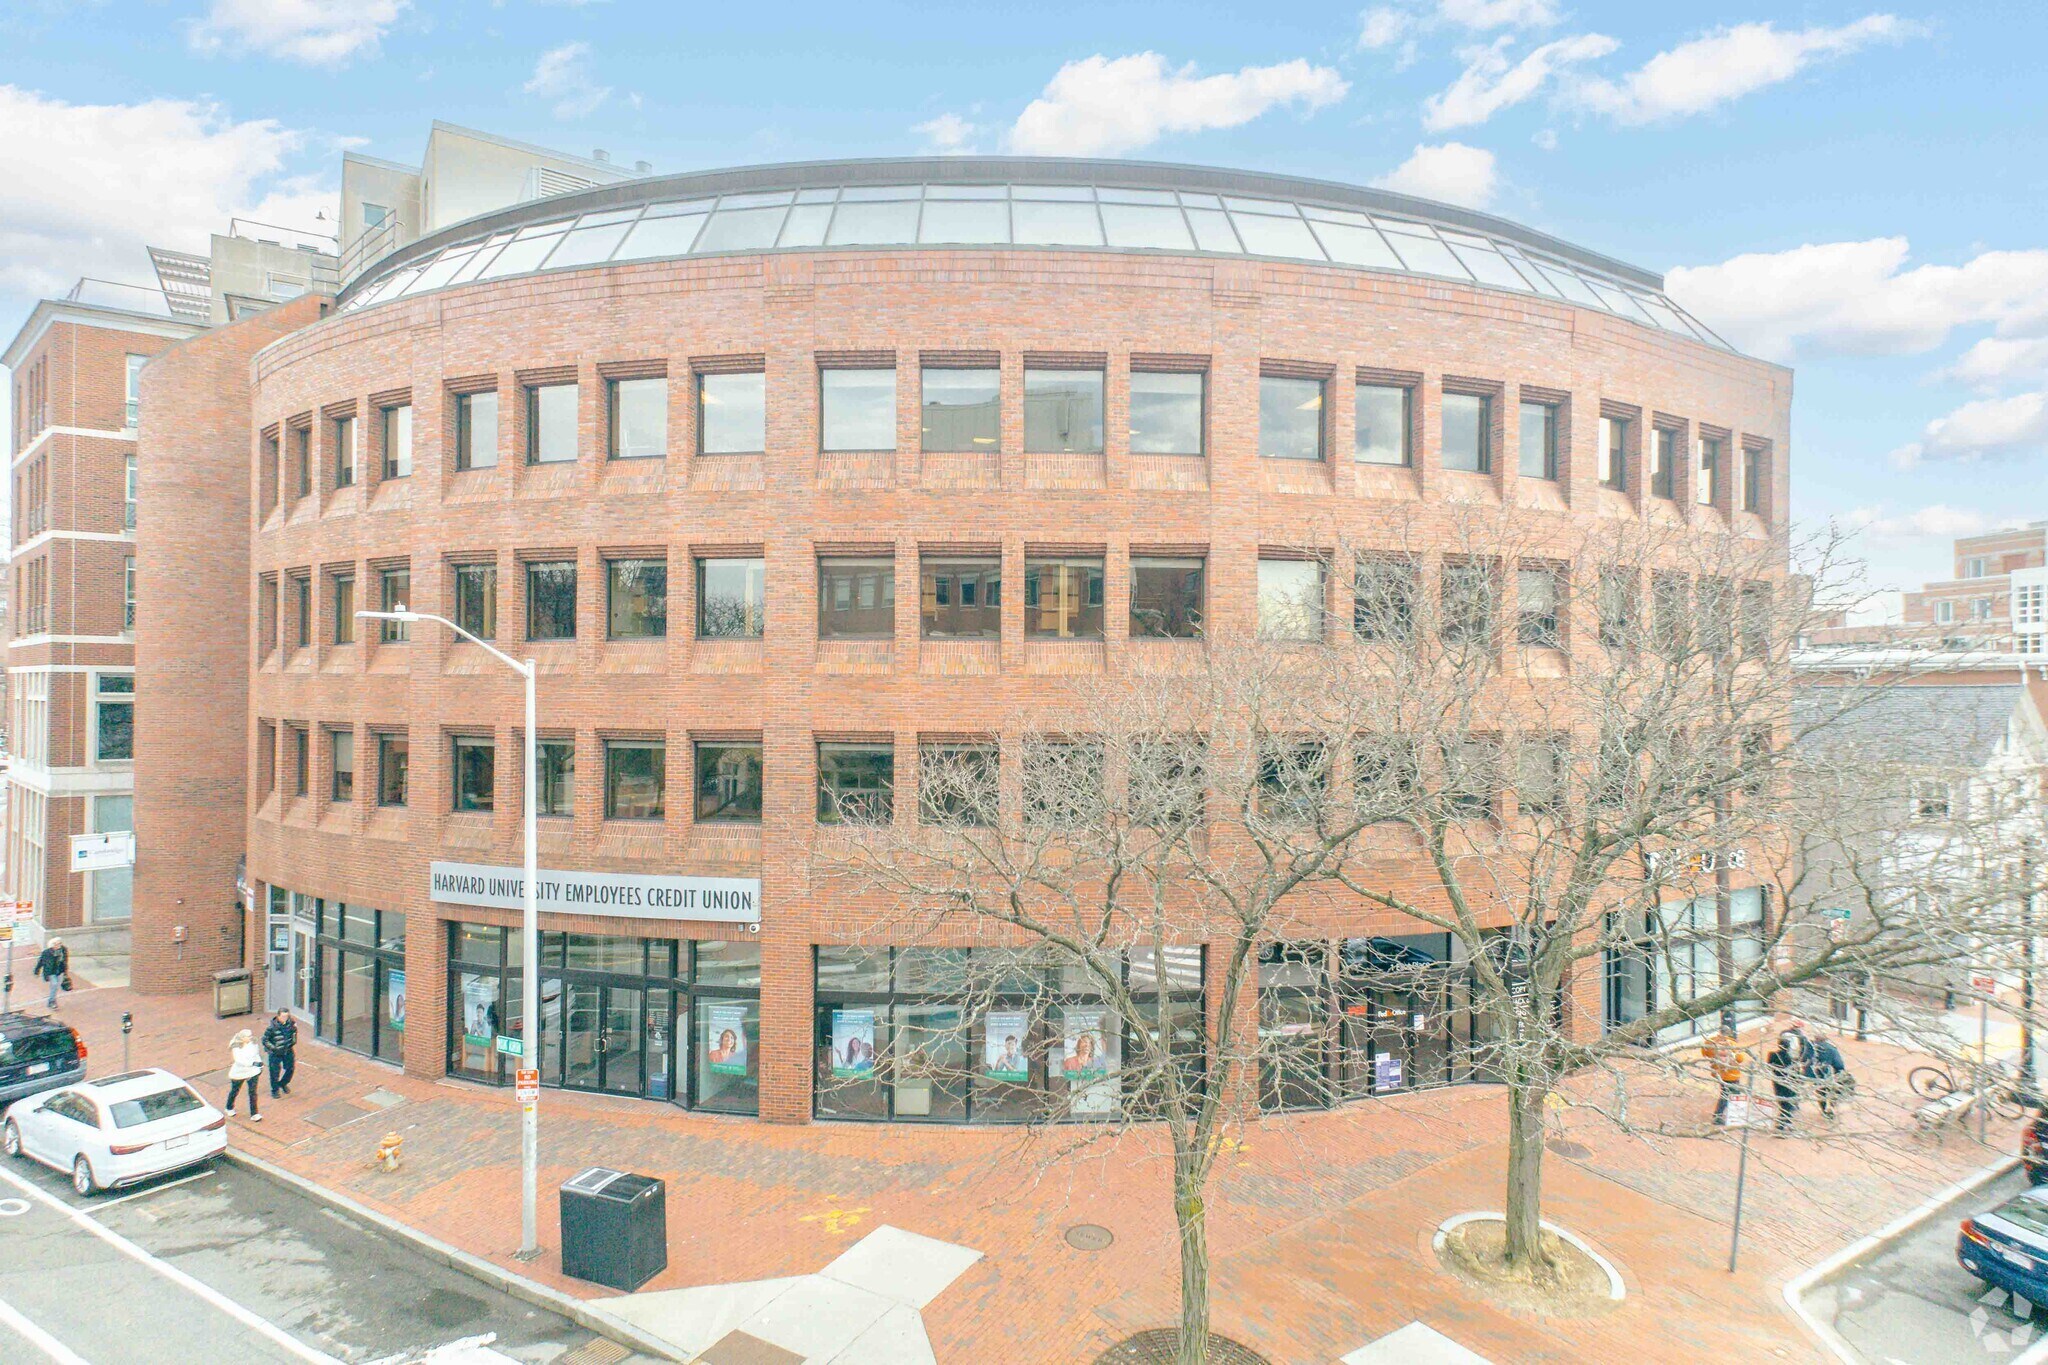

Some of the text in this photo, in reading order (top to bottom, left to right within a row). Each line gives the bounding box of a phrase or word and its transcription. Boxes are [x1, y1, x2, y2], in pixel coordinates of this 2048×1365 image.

[434, 873, 752, 910] HARVARD UNIVESITY EMPLOYEES CREDIT UNION
